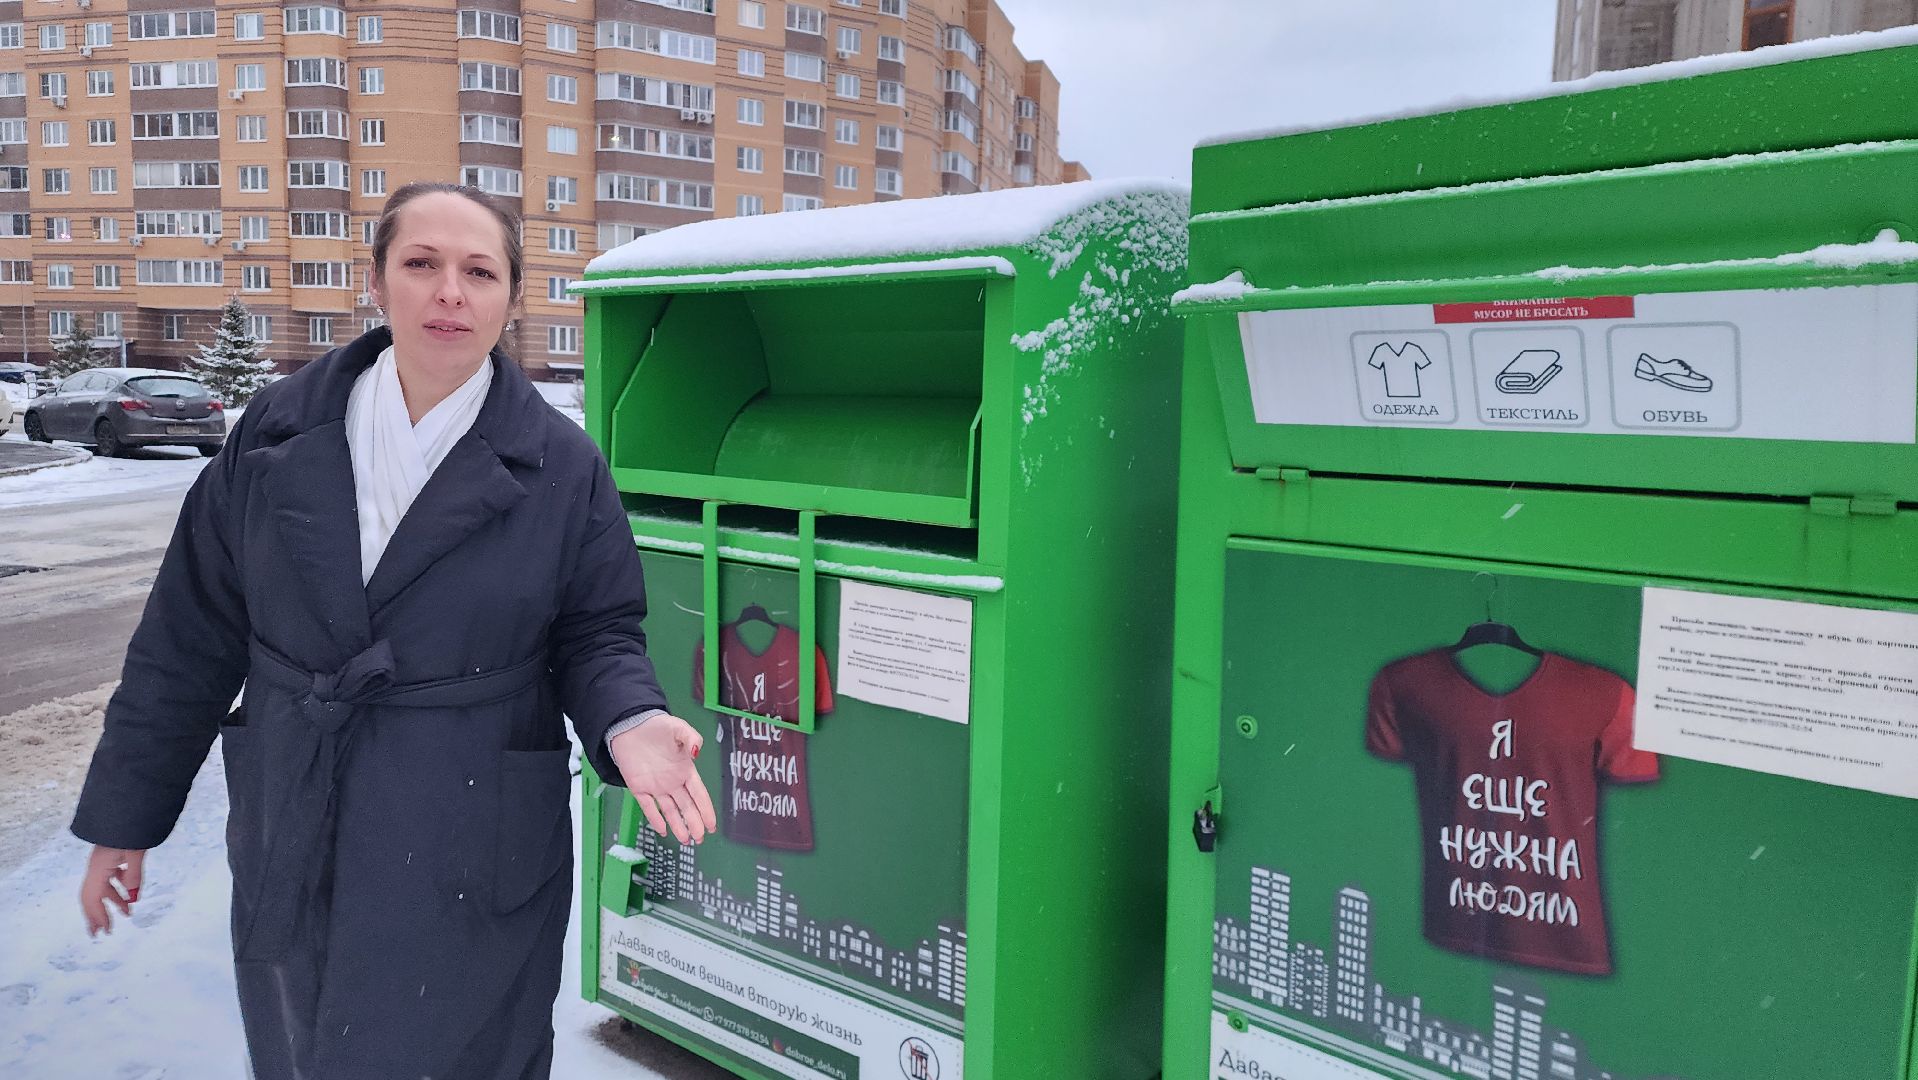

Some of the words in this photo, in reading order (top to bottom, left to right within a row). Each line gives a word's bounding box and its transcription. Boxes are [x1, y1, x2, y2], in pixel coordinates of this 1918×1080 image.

[1473, 309, 1513, 319] МУСОР
[1515, 308, 1531, 318] НЕ
[1533, 306, 1588, 318] БРОСАТЬ
[1372, 403, 1440, 417] ОДЕЖДА
[1486, 406, 1579, 421] ТЕКСТИЛЬ
[1642, 409, 1709, 424] ОБУВЬ
[753, 673, 765, 702] Я
[1489, 719, 1512, 760] Я
[730, 750, 799, 786] НУЖНА
[733, 787, 798, 818] ЛЮДЯМ
[1462, 773, 1549, 822] ЕЩЕ
[1440, 824, 1581, 881] НУЖНА
[1450, 877, 1578, 927] ЛЮДЯМ
[617, 930, 655, 959] Давая
[656, 949, 697, 977] своим
[699, 964, 746, 998] вещам
[747, 986, 808, 1024] вторую
[811, 1012, 863, 1047] жизнь
[1219, 1047, 1287, 1080] Дава
